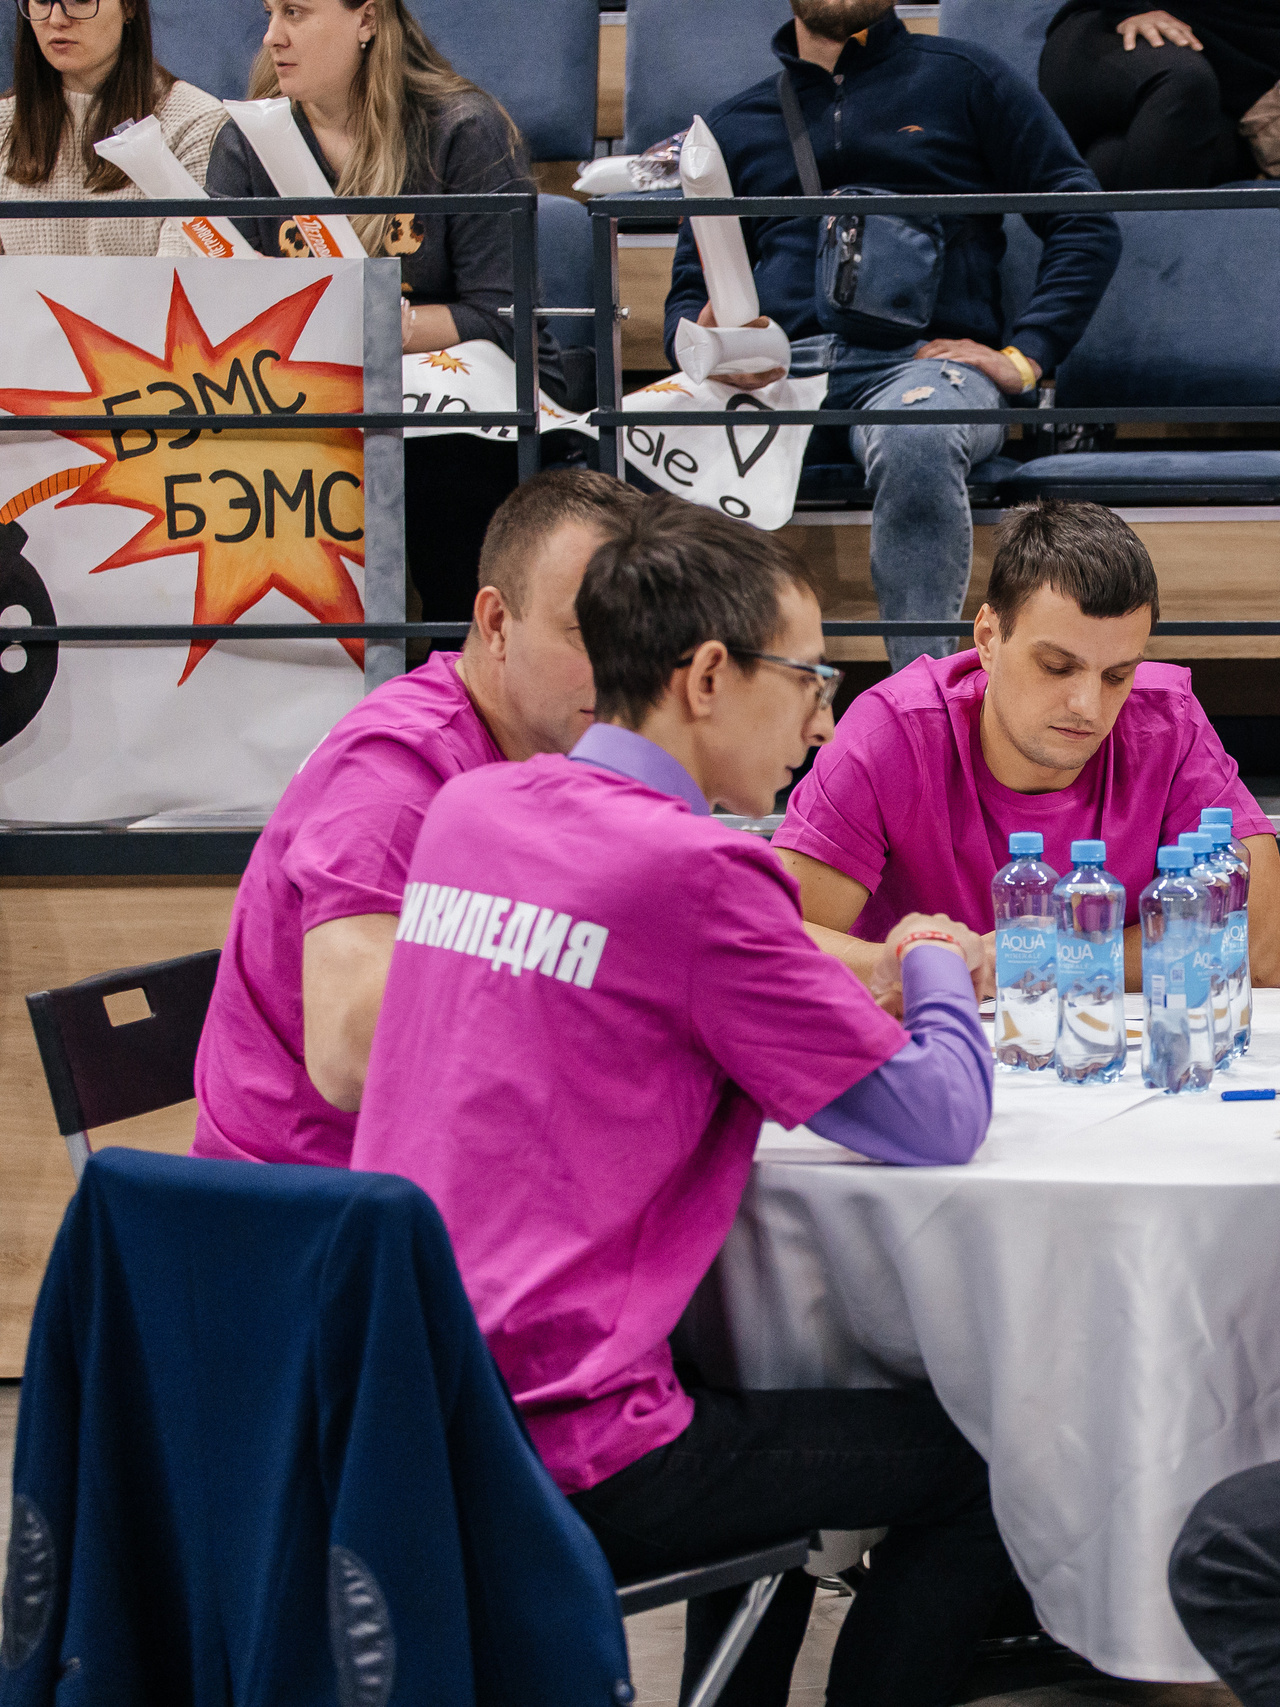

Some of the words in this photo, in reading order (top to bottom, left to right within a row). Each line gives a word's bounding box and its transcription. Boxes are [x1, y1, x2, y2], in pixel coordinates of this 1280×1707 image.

[102, 349, 307, 462] БЭМС
[164, 468, 365, 543] БЭМС
[1001, 933, 1046, 953] AQUA
[1057, 943, 1094, 964] QUA
